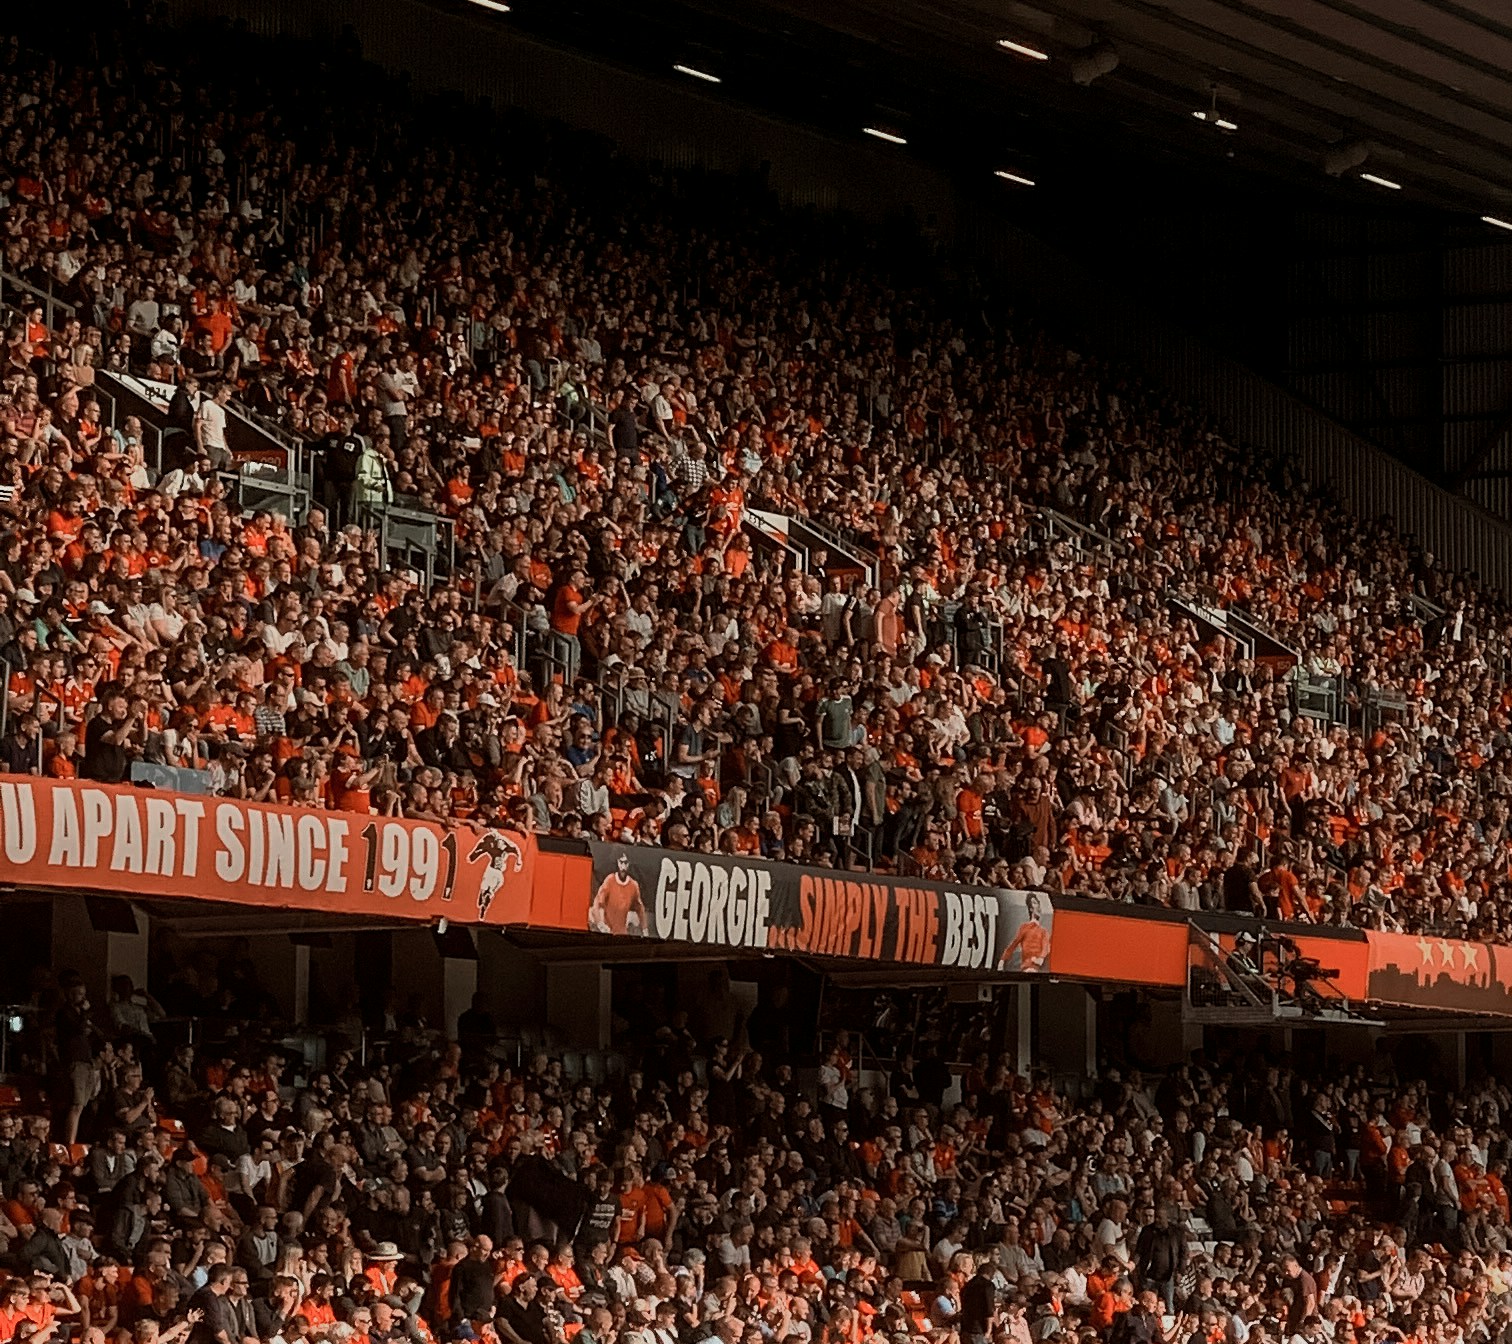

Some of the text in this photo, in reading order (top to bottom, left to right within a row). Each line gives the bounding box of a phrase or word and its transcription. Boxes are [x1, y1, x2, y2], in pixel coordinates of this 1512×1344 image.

[0, 781, 457, 902] U APART SINCE 1991
[797, 874, 889, 960] SIMPLY
[894, 886, 939, 965] THE
[942, 891, 999, 970] BEST
